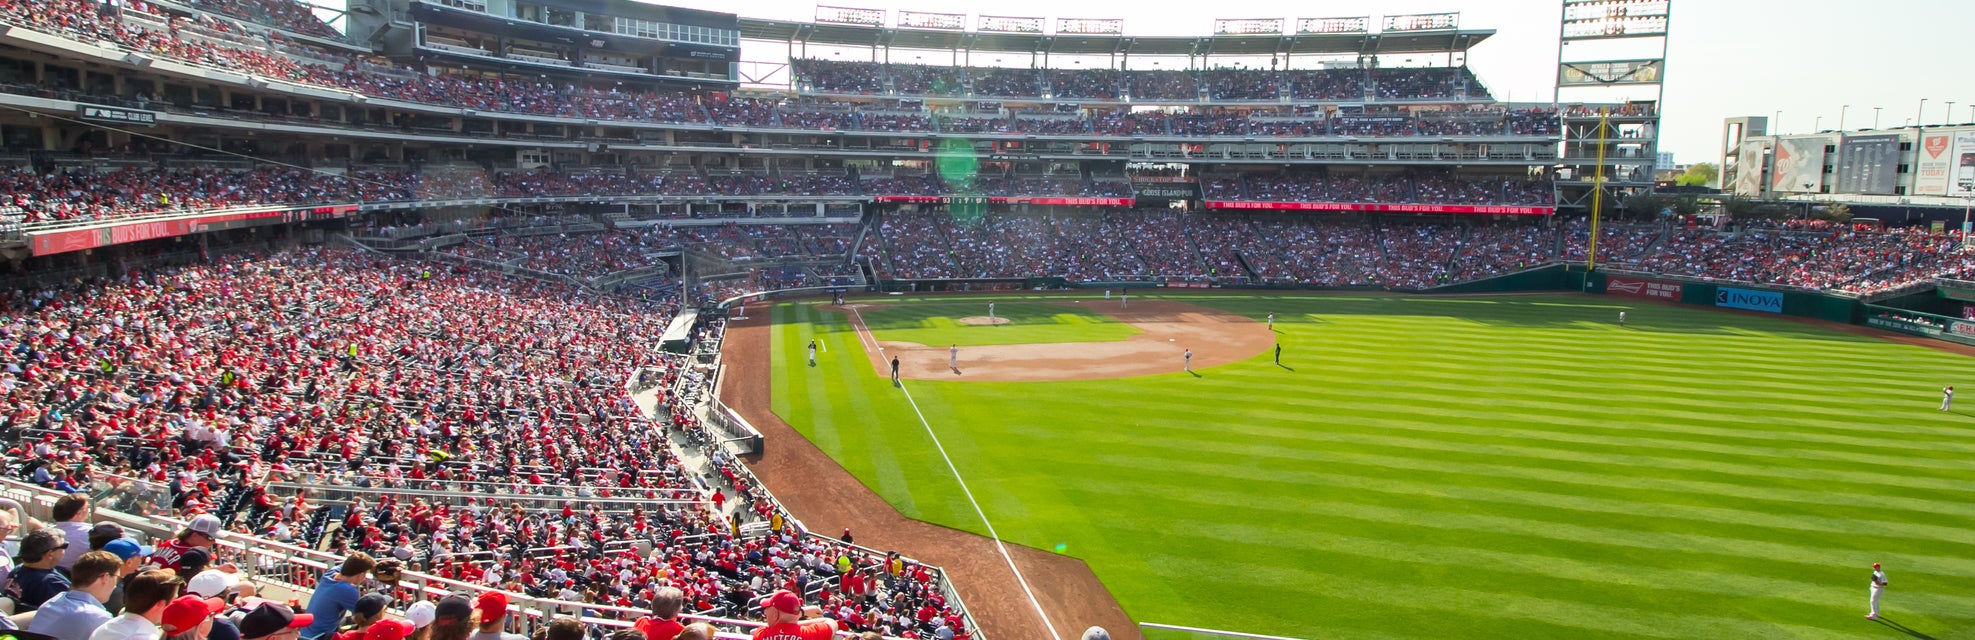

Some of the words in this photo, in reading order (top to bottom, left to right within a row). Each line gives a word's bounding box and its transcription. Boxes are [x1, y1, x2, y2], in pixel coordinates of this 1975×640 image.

[1143, 188, 1161, 197] GOOSE
[1161, 189, 1182, 197] ISLAND
[1066, 197, 1078, 205] THIS
[1079, 197, 1096, 205] BUD'S
[1097, 197, 1108, 205] FOR
[1388, 204, 1401, 212] THIS
[1401, 204, 1419, 212] BUD'S
[1419, 204, 1431, 212] FOR
[1473, 206, 1487, 214] THIS
[1487, 206, 1506, 214] BUD'S
[1506, 206, 1519, 214] FOR
[92, 228, 112, 247] THIS
[112, 225, 136, 245] BUD'S
[136, 223, 150, 241] FOR
[150, 221, 170, 238] YOU.
[1647, 282, 1661, 290] THIS
[1662, 284, 1681, 292] BUD'S
[1646, 289, 1659, 297] FOR
[1732, 292, 1781, 308] INOVA
